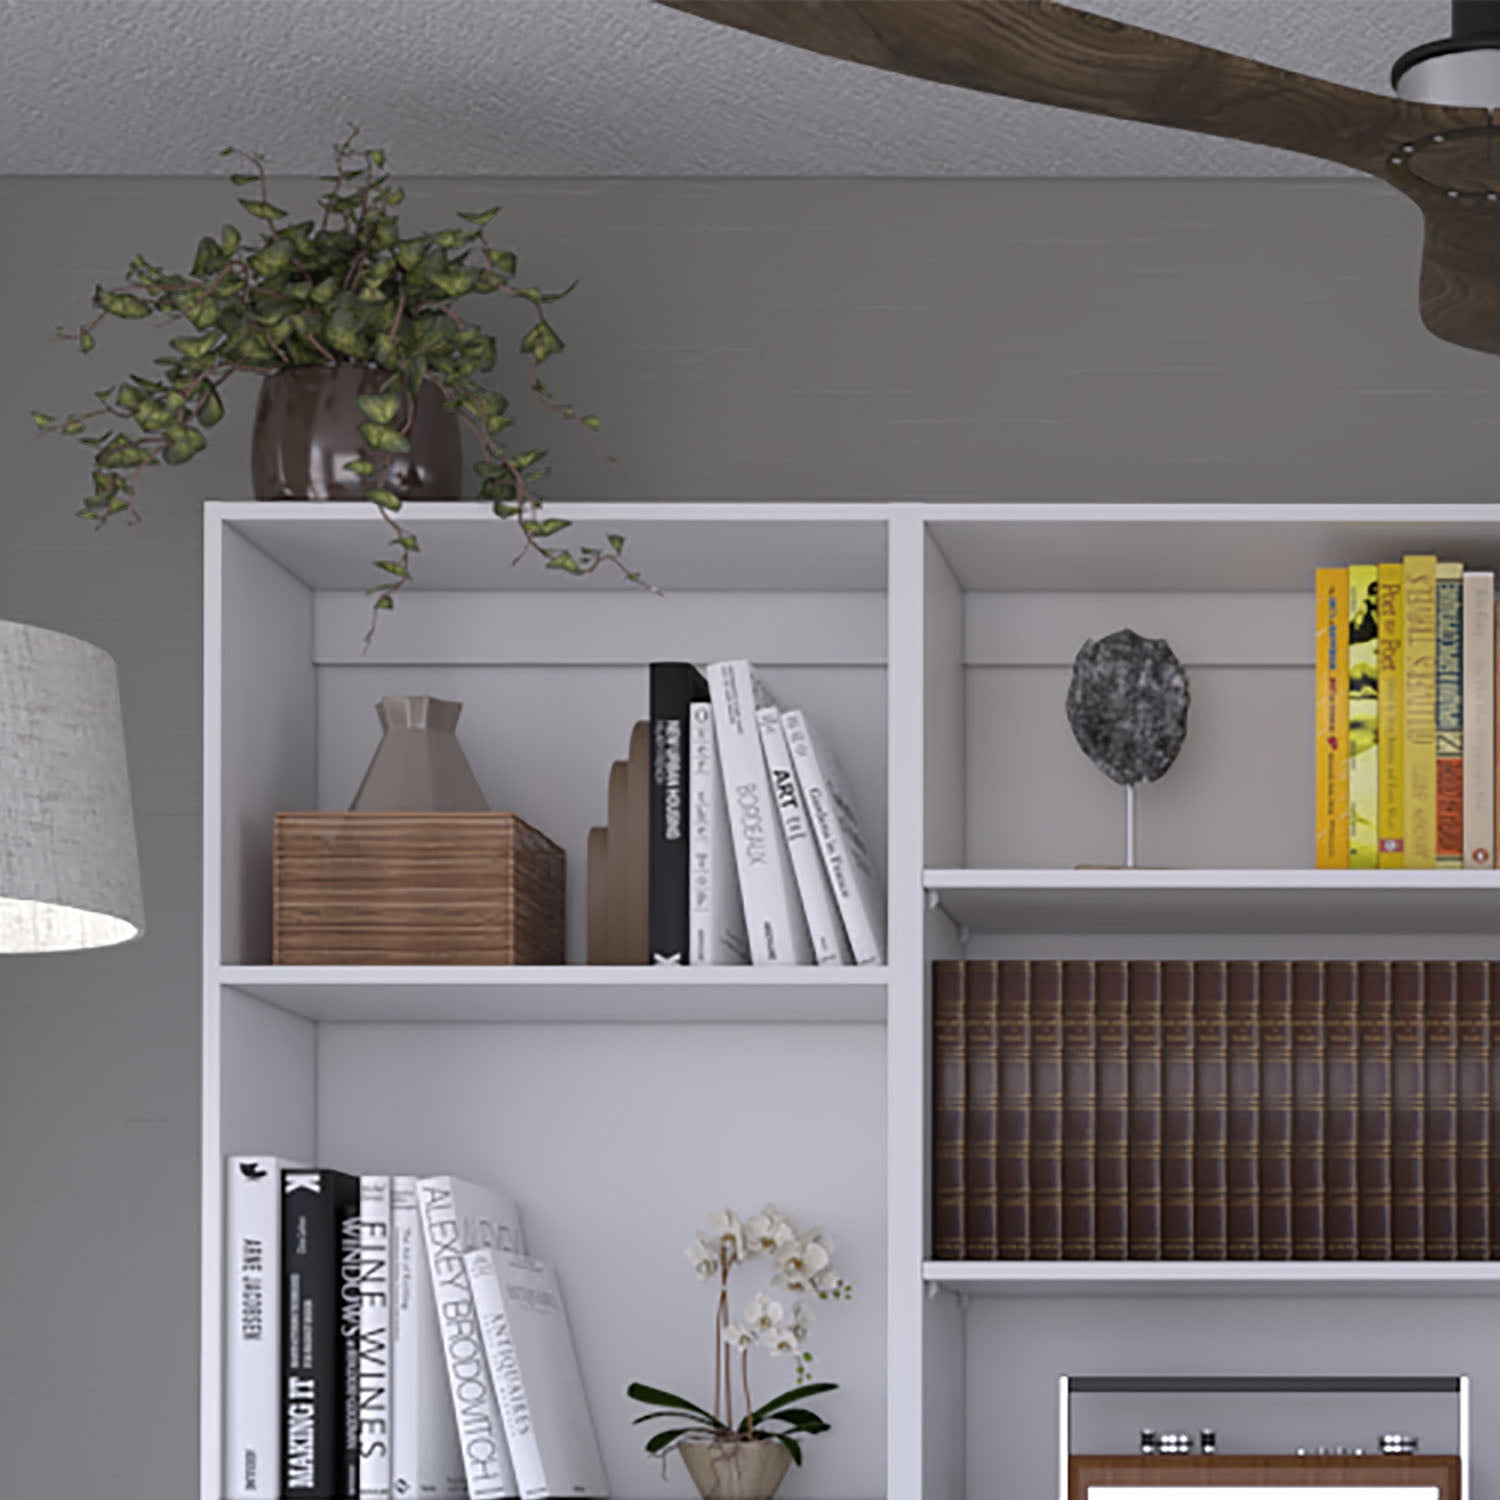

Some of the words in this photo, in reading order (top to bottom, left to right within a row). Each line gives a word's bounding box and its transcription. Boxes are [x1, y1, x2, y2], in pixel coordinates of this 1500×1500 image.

[736, 783, 767, 867] BORDEAUX
[773, 768, 798, 810] ART
[284, 1174, 321, 1194] K
[242, 1238, 262, 1272] ARNE
[341, 1217, 361, 1337] WINDOWS
[360, 1222, 386, 1307] FINE
[421, 1185, 468, 1291] ALEXEY
[242, 1276, 262, 1340] JACOBSEN
[288, 1376, 315, 1399] IT
[360, 1327, 386, 1458] WINES
[441, 1300, 498, 1482] BRODOVITCH
[489, 1312, 530, 1437] ANTIQUAIRES
[288, 1404, 315, 1488] MAKING
